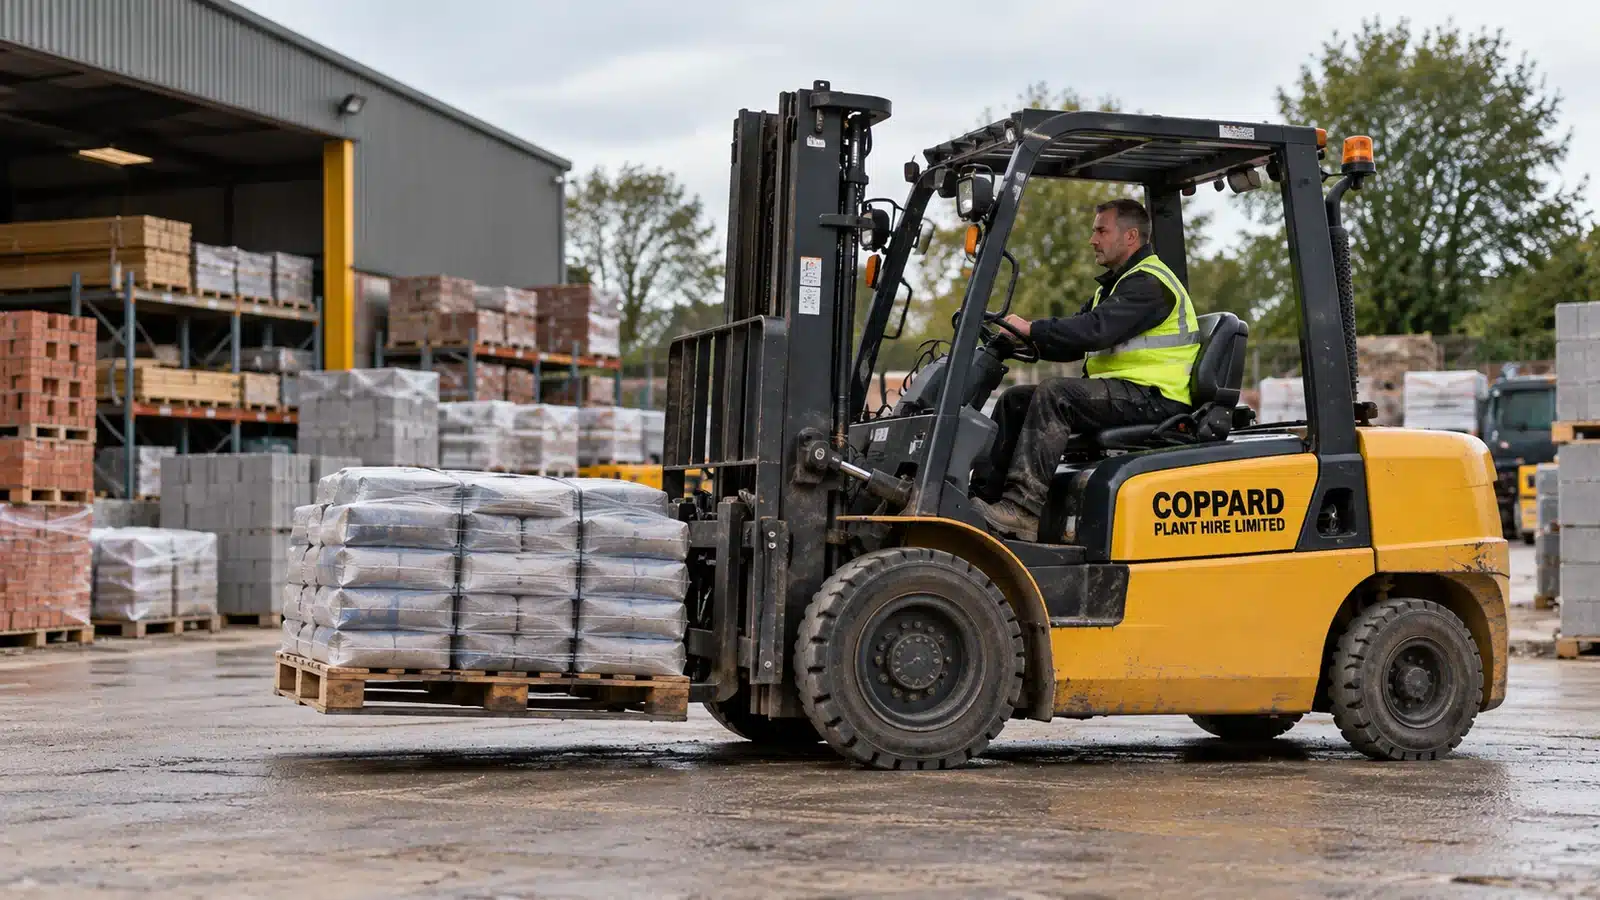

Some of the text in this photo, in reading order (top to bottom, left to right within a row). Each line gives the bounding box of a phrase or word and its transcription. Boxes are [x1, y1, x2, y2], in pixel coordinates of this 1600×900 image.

[1153, 488, 1284, 519] COPPARD
[1154, 518, 1285, 536] PLANT HIRE LIMITED
